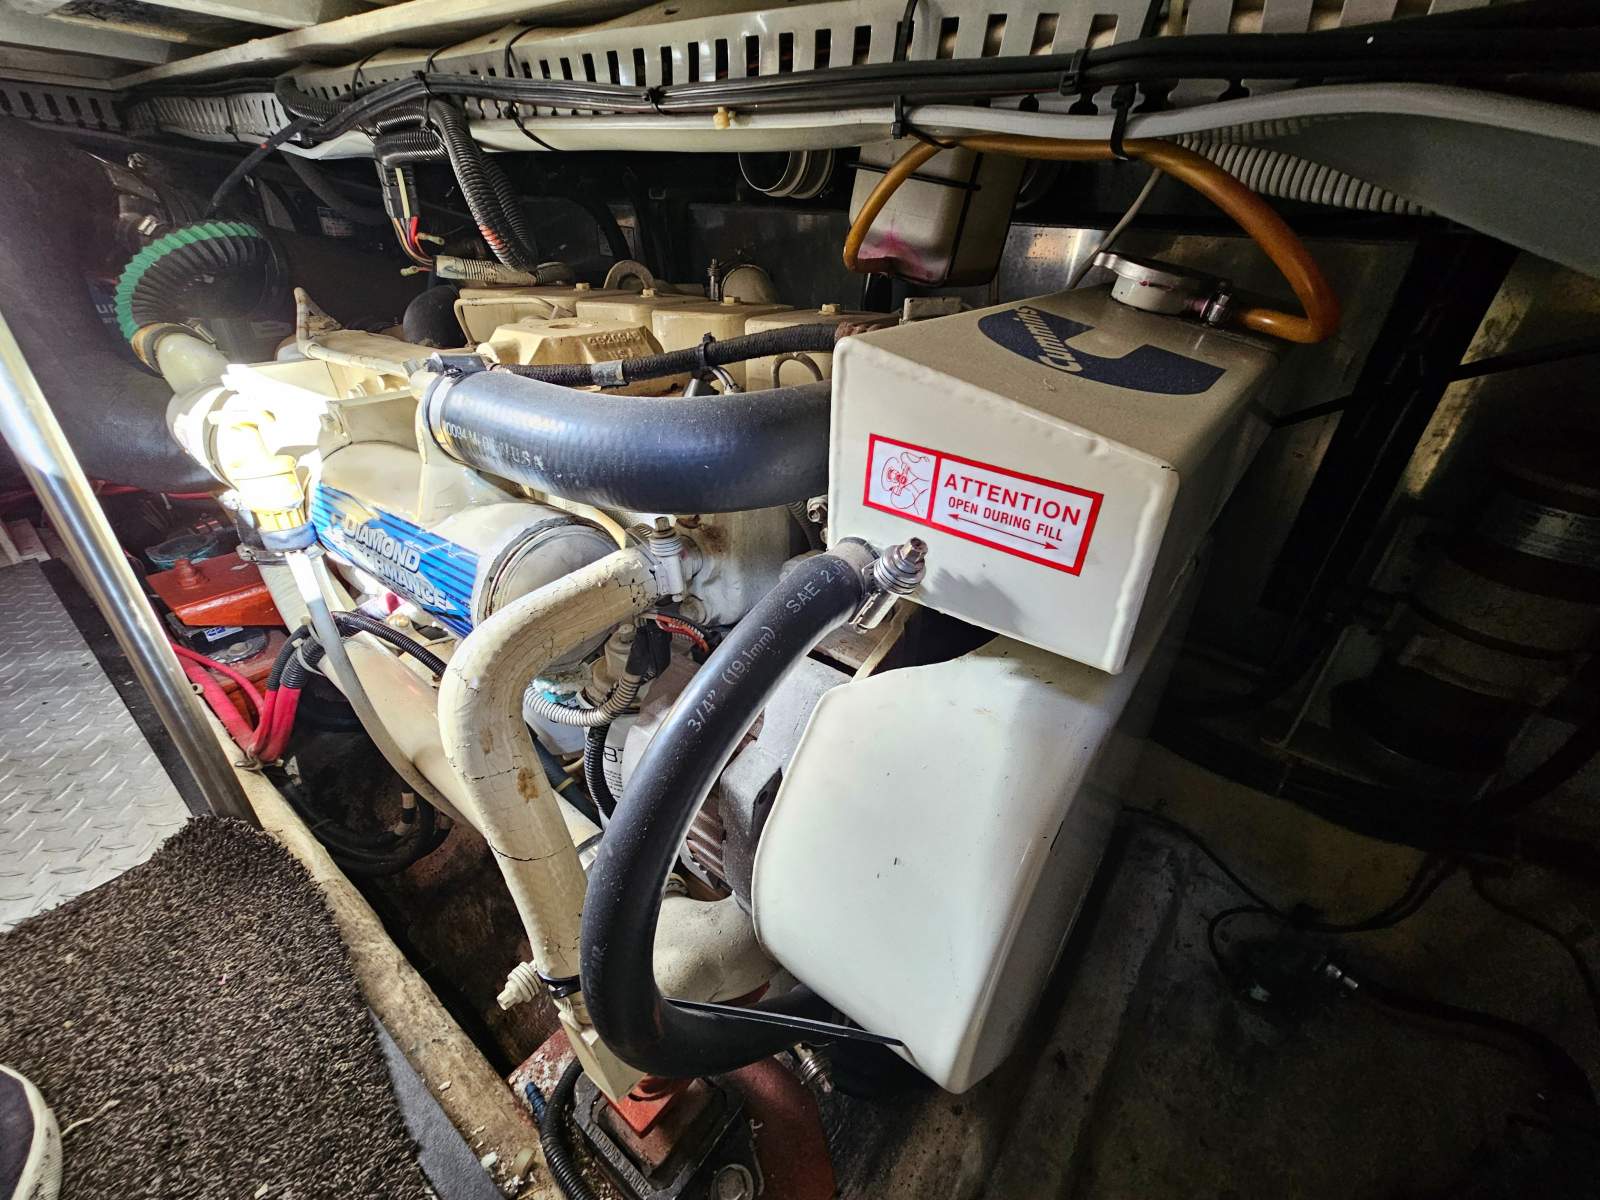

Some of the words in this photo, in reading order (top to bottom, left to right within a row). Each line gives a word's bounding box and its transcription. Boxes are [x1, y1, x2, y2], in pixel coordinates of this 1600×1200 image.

[1011, 306, 1084, 373] Cummins
[944, 474, 1081, 526] ATTENTION
[948, 496, 979, 516] OPEN
[983, 507, 1031, 532] DURING
[1036, 522, 1064, 542] FILL
[785, 581, 822, 614] SAE
